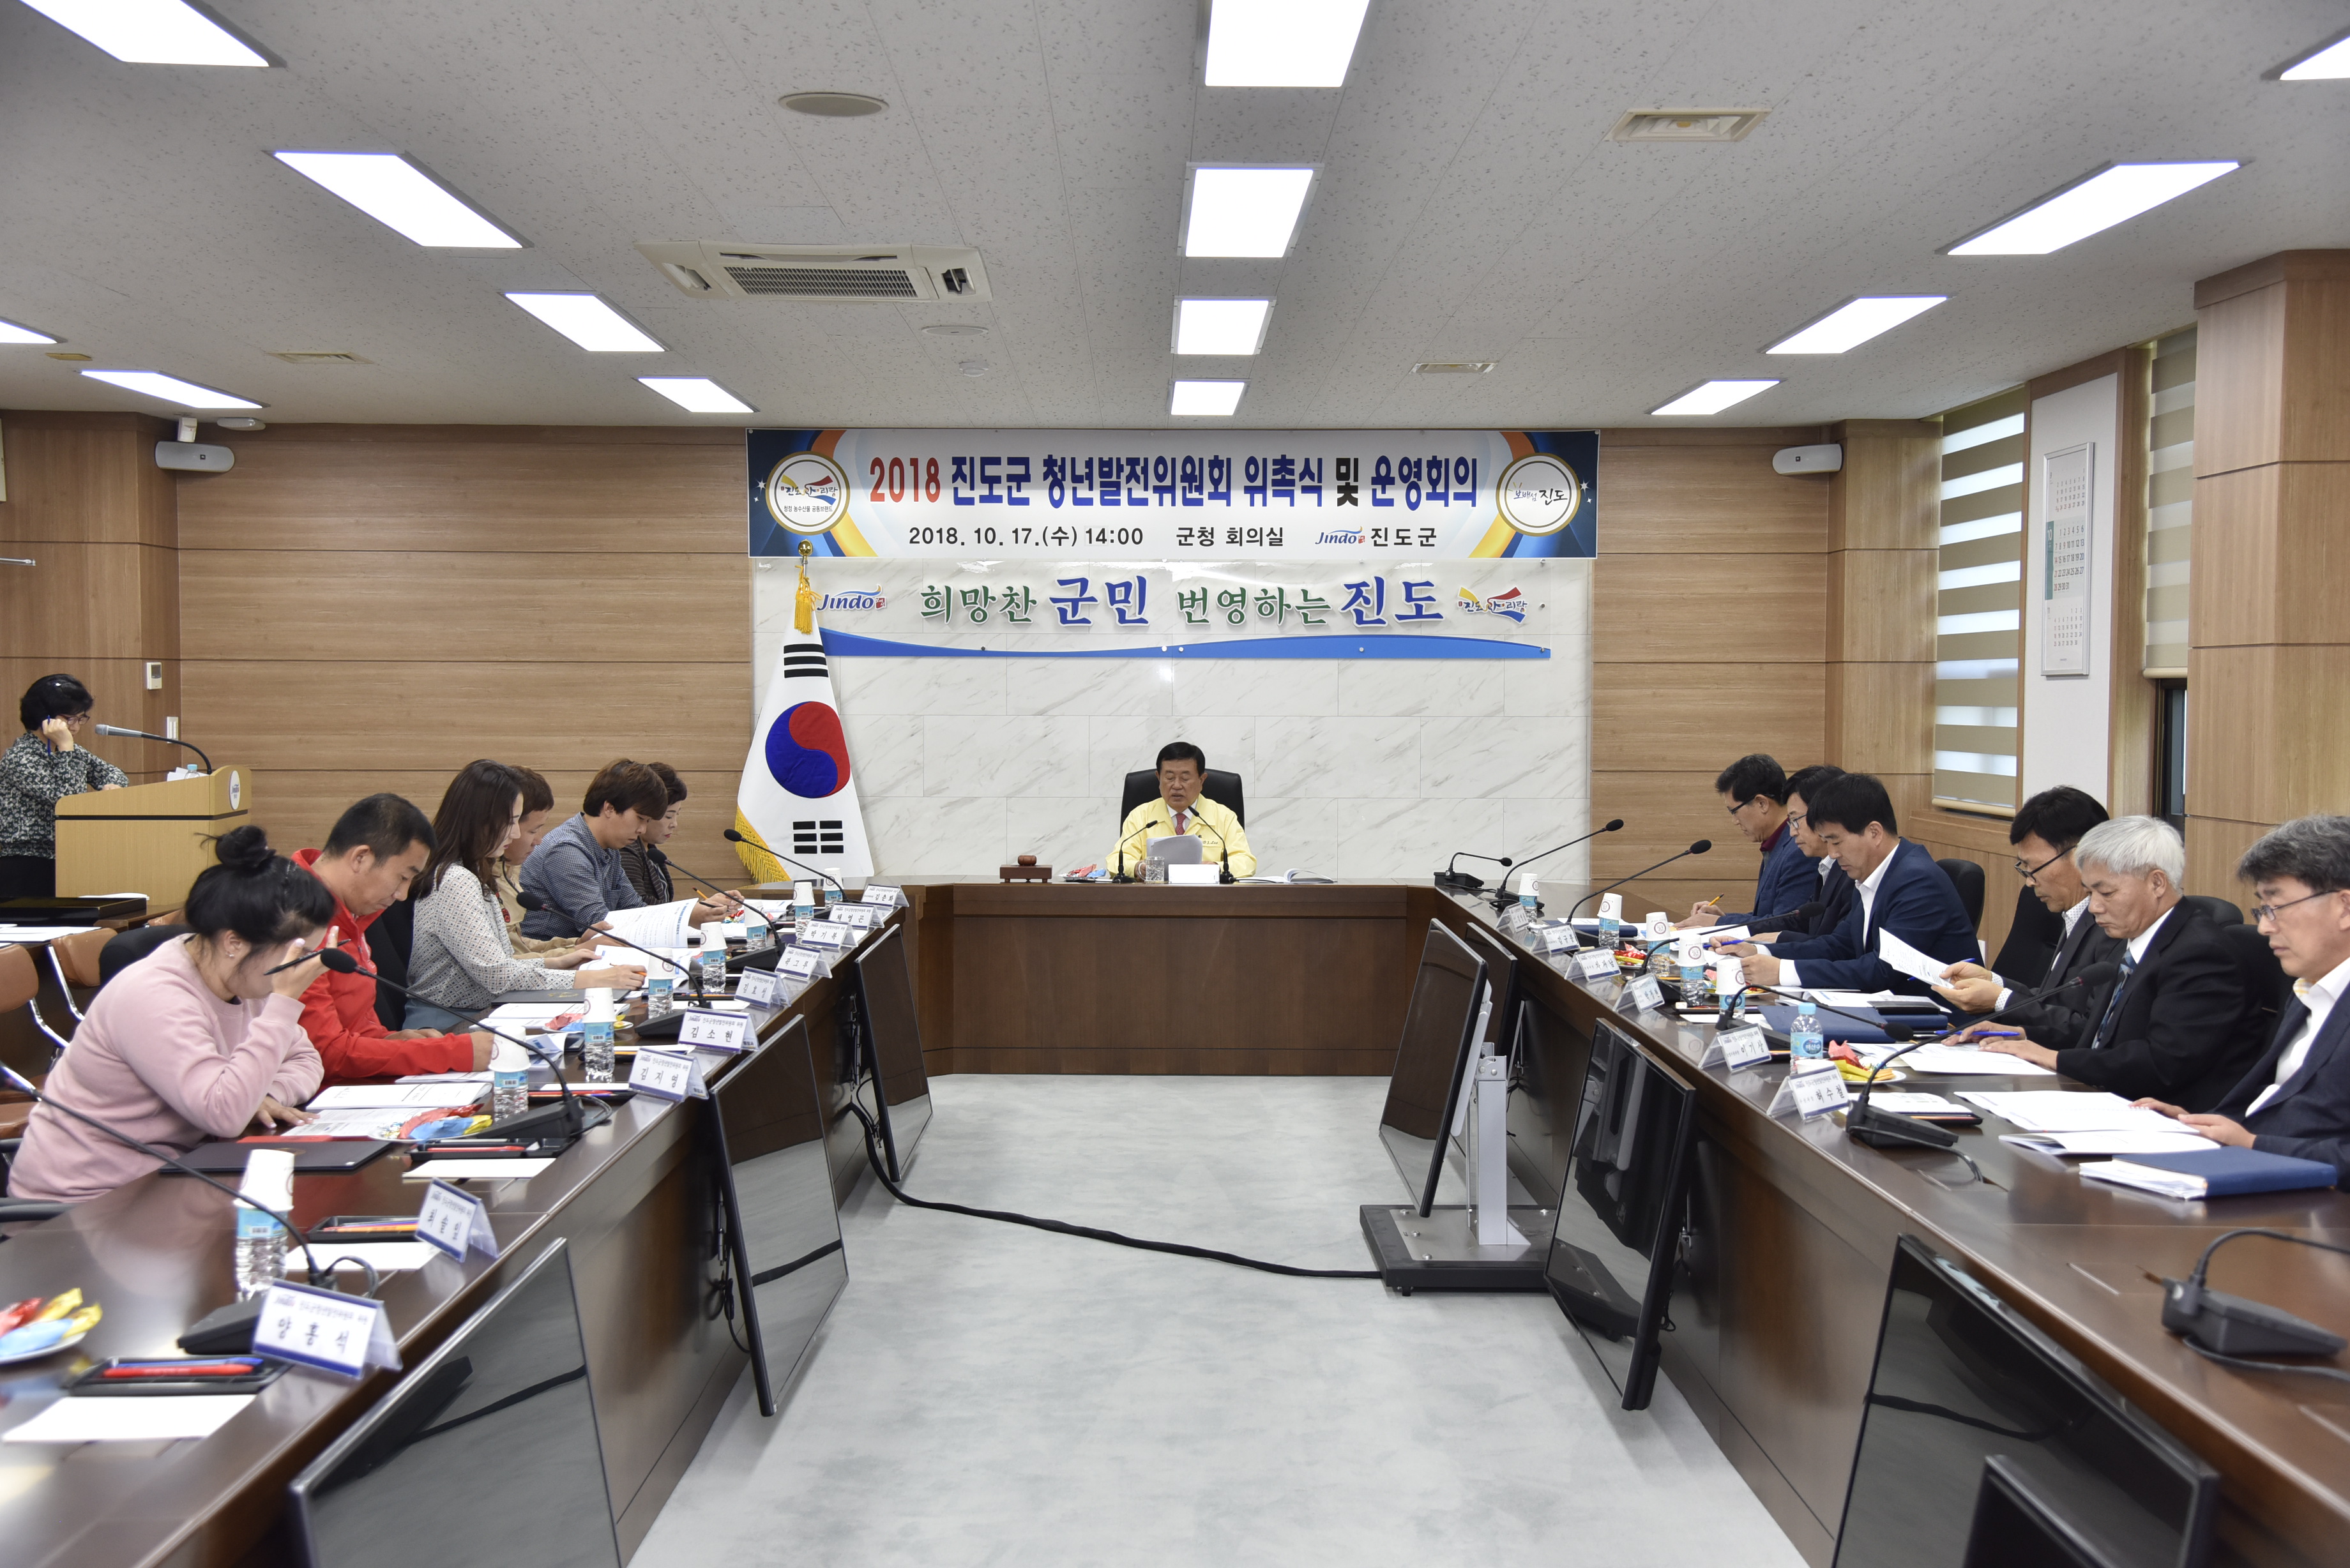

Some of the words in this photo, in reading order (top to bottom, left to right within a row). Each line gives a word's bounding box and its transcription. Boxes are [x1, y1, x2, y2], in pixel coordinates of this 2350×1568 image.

[870, 457, 941, 502] 2018
[951, 456, 1031, 506] 진도군
[1043, 455, 1231, 509] 청년발전위원회
[1243, 455, 1323, 507] 위촉식
[1336, 456, 1360, 507] 및
[1371, 455, 1477, 511] 운영회의
[1539, 488, 1568, 505] 진도
[909, 527, 965, 547] 2018.
[1085, 527, 1143, 545] 14:00
[1176, 527, 1215, 547] 군청
[1225, 527, 1284, 547] 회의실
[1370, 527, 1437, 547] 진도군
[2047, 528, 2052, 541] 10
[817, 591, 876, 611] Jindo
[920, 585, 1038, 624] 희망찬
[1050, 575, 1149, 626] 군민
[1177, 586, 1331, 626] 번영하는
[1340, 575, 1444, 626] 진도
[641, 1067, 678, 1088] 김지영
